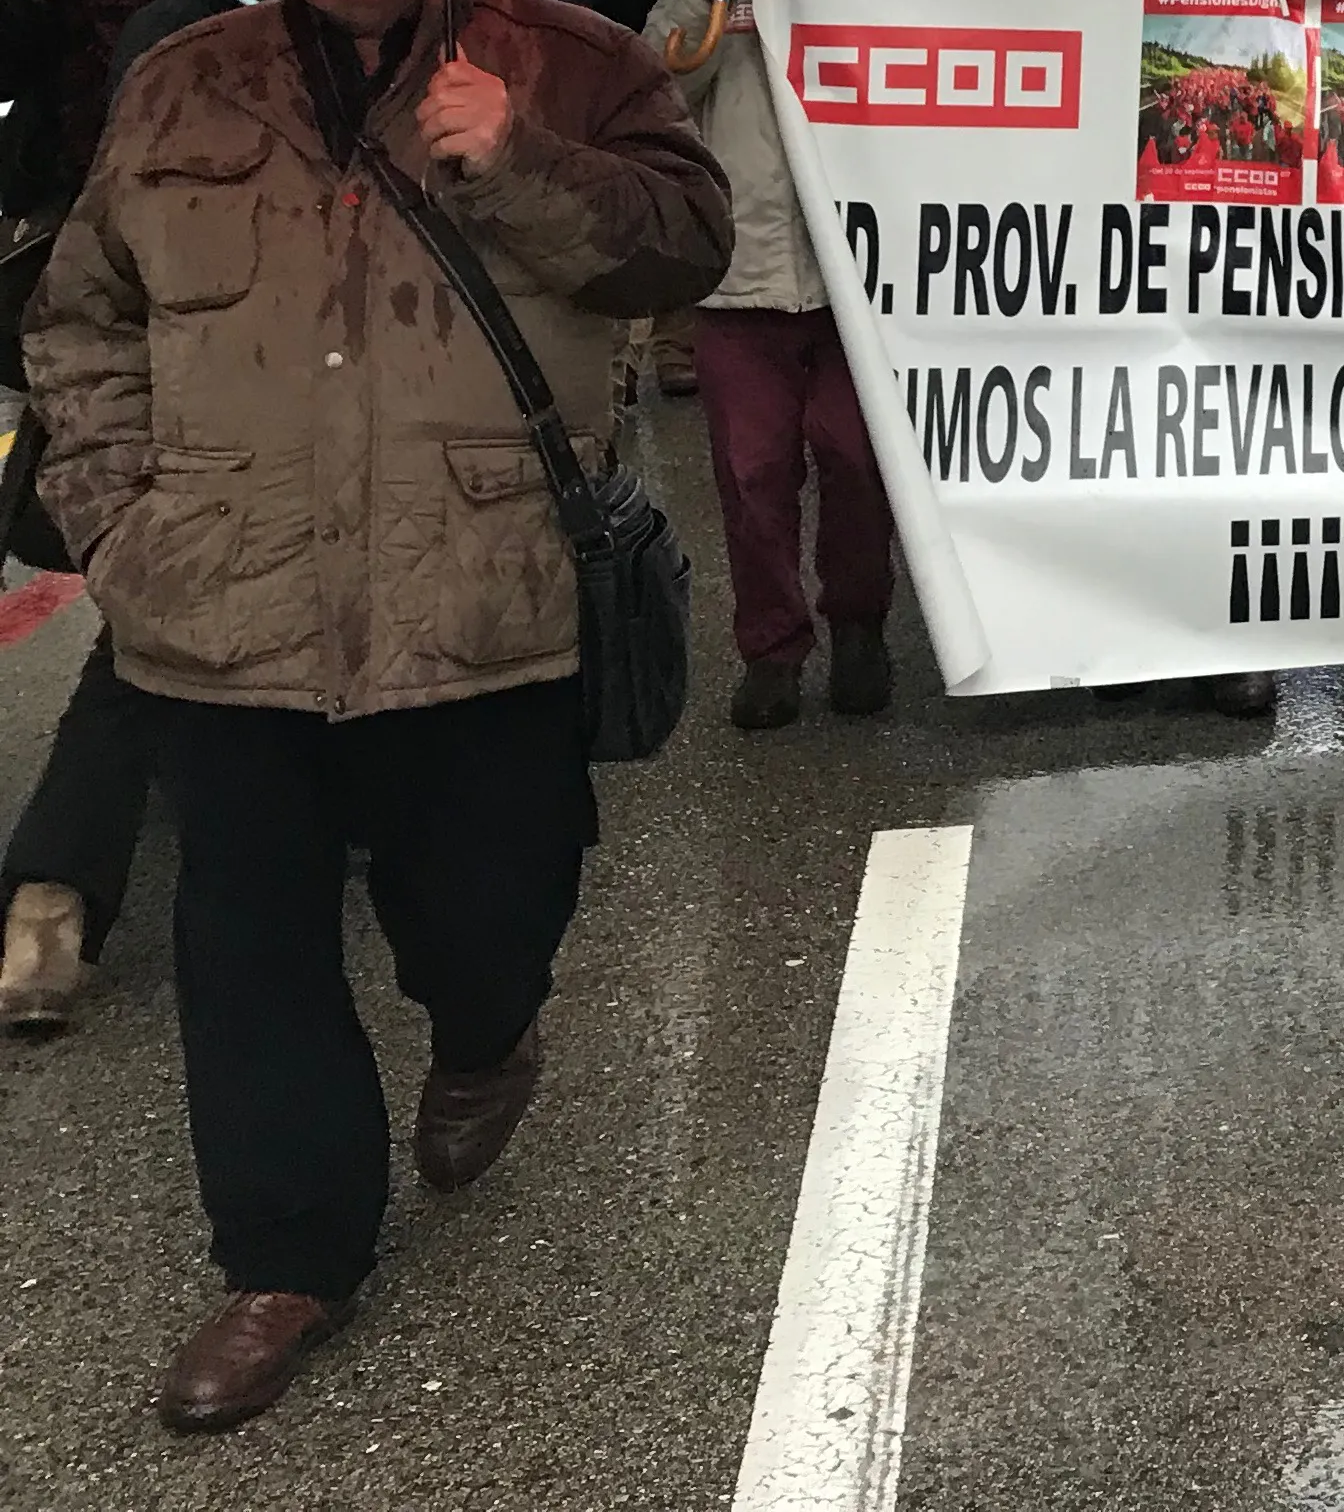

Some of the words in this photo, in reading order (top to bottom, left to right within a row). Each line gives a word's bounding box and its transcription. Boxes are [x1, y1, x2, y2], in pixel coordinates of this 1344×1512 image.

[803, 46, 1064, 108] CCOO
[1217, 167, 1279, 186] CCOO
[835, 200, 894, 316] D.
[916, 202, 1076, 316] PROV.
[1099, 202, 1170, 315] DE
[893, 365, 1052, 484] IMOS
[1070, 364, 1139, 479] LA
